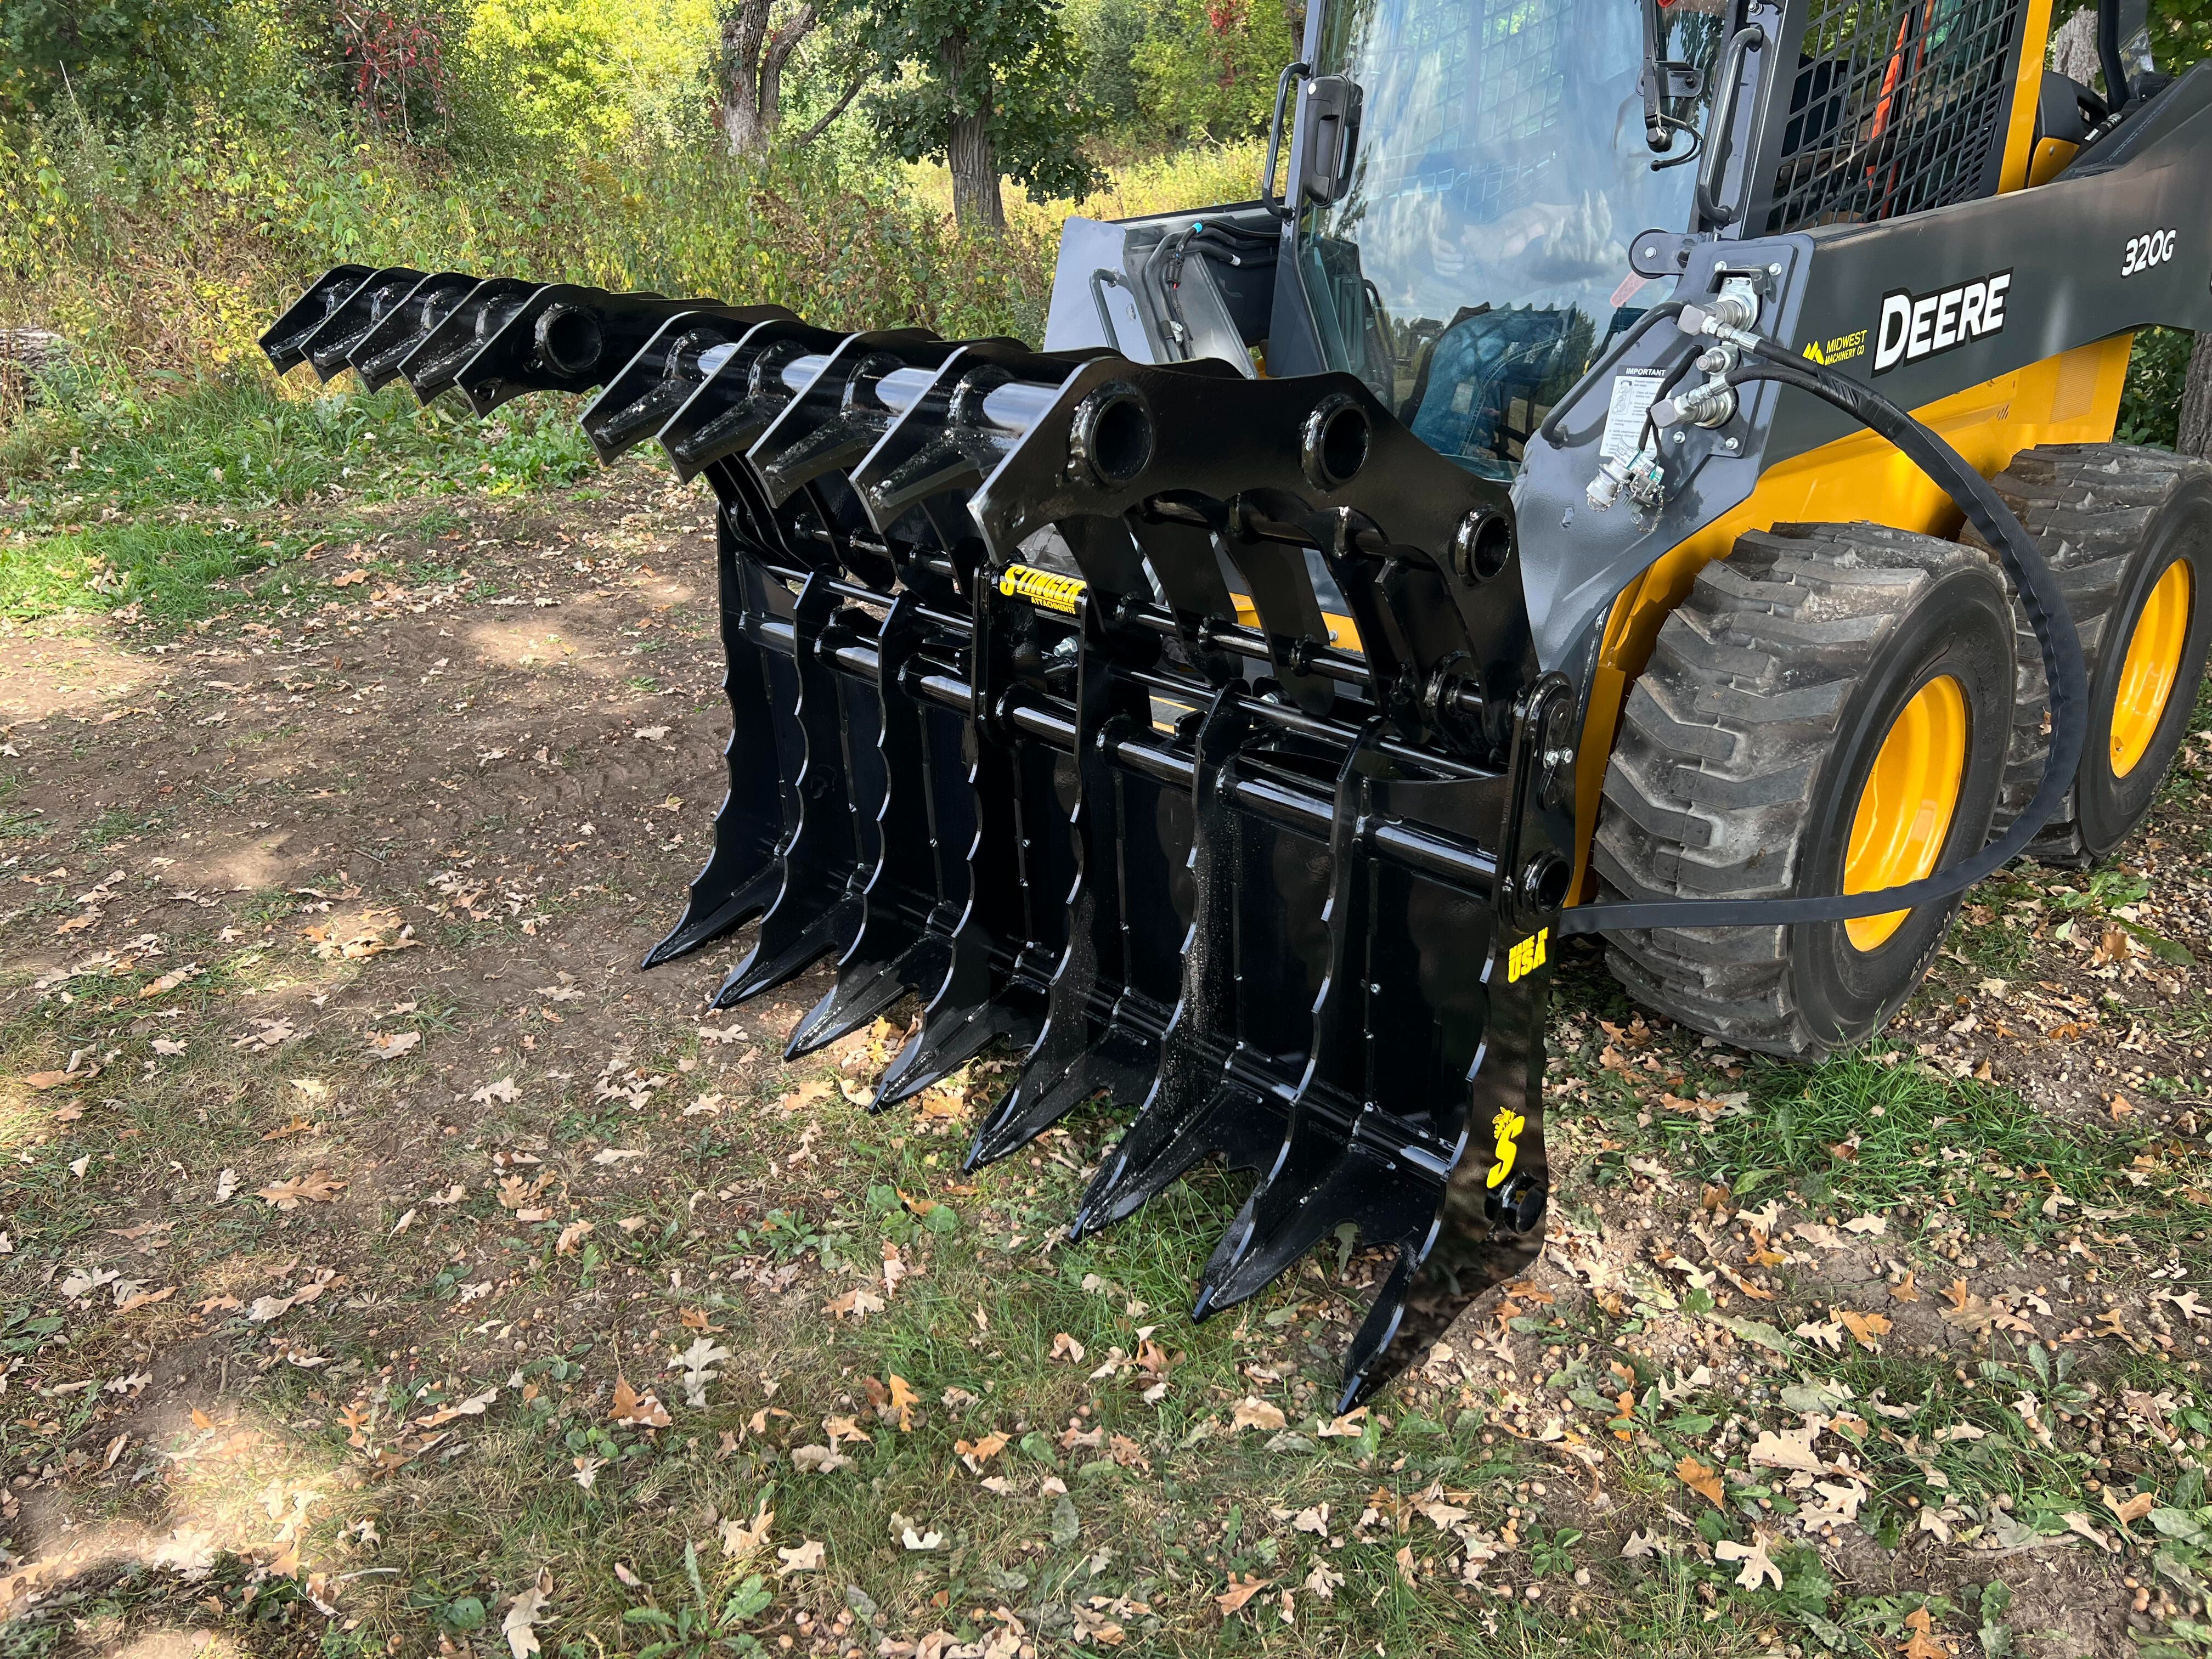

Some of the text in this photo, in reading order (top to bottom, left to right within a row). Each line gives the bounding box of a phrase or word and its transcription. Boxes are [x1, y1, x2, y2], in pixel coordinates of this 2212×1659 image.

[2121, 229, 2176, 276] 320G
[1874, 273, 2011, 370] DEERE
[1824, 345, 1865, 366] MACHINERY CO
[1826, 329, 1868, 354] MIDWEST
[1626, 368, 1667, 376] IMPORTANT
[999, 565, 1087, 604] STINGER
[1031, 596, 1076, 615] ATTACHMENTS
[1509, 927, 1549, 960] MADE IN
[1508, 939, 1547, 983] USA
